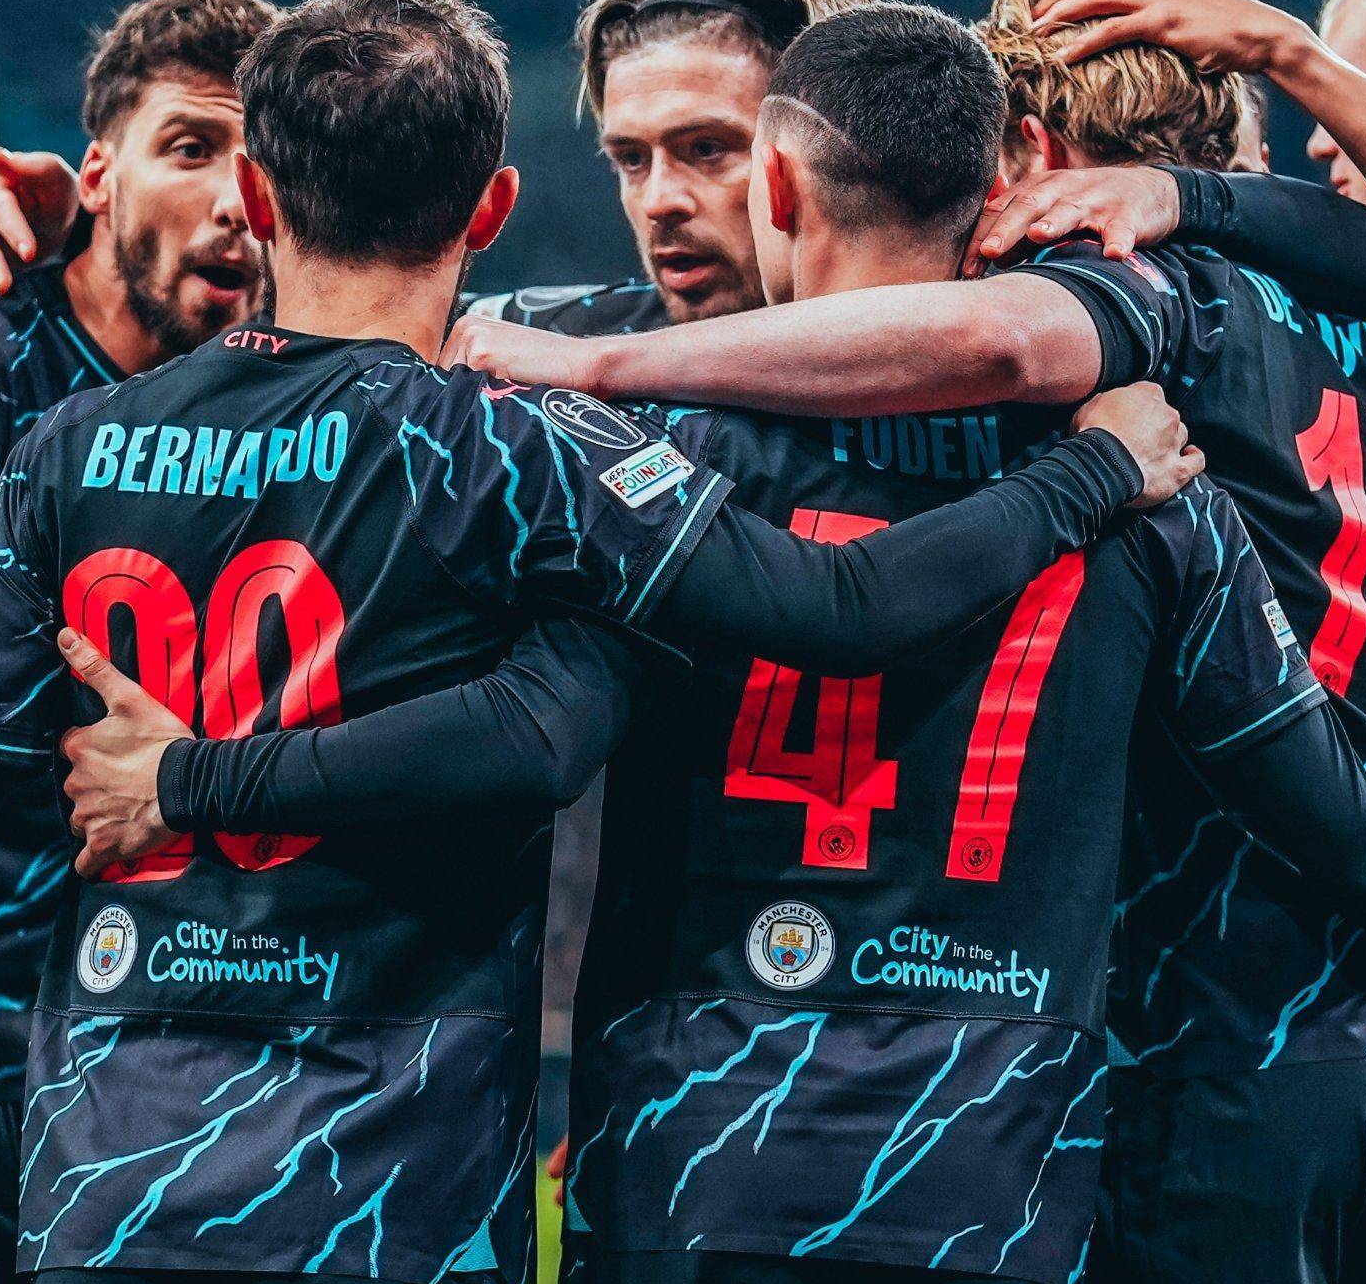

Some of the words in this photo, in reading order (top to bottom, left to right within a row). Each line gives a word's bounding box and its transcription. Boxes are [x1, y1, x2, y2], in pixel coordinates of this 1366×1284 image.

[223, 331, 289, 354] CITY
[605, 466, 629, 483] UEFA
[89, 910, 134, 937] MANCHESTER
[757, 906, 828, 938] MANCHESTER
[176, 921, 229, 955] City
[232, 934, 247, 950] in
[251, 934, 279, 950] the
[889, 925, 950, 961] City
[953, 942, 965, 958] in
[968, 944, 993, 961] the
[92, 977, 111, 986] CITY
[146, 935, 340, 1001] Community
[773, 974, 800, 984] CITY
[851, 938, 1051, 1014] Community
